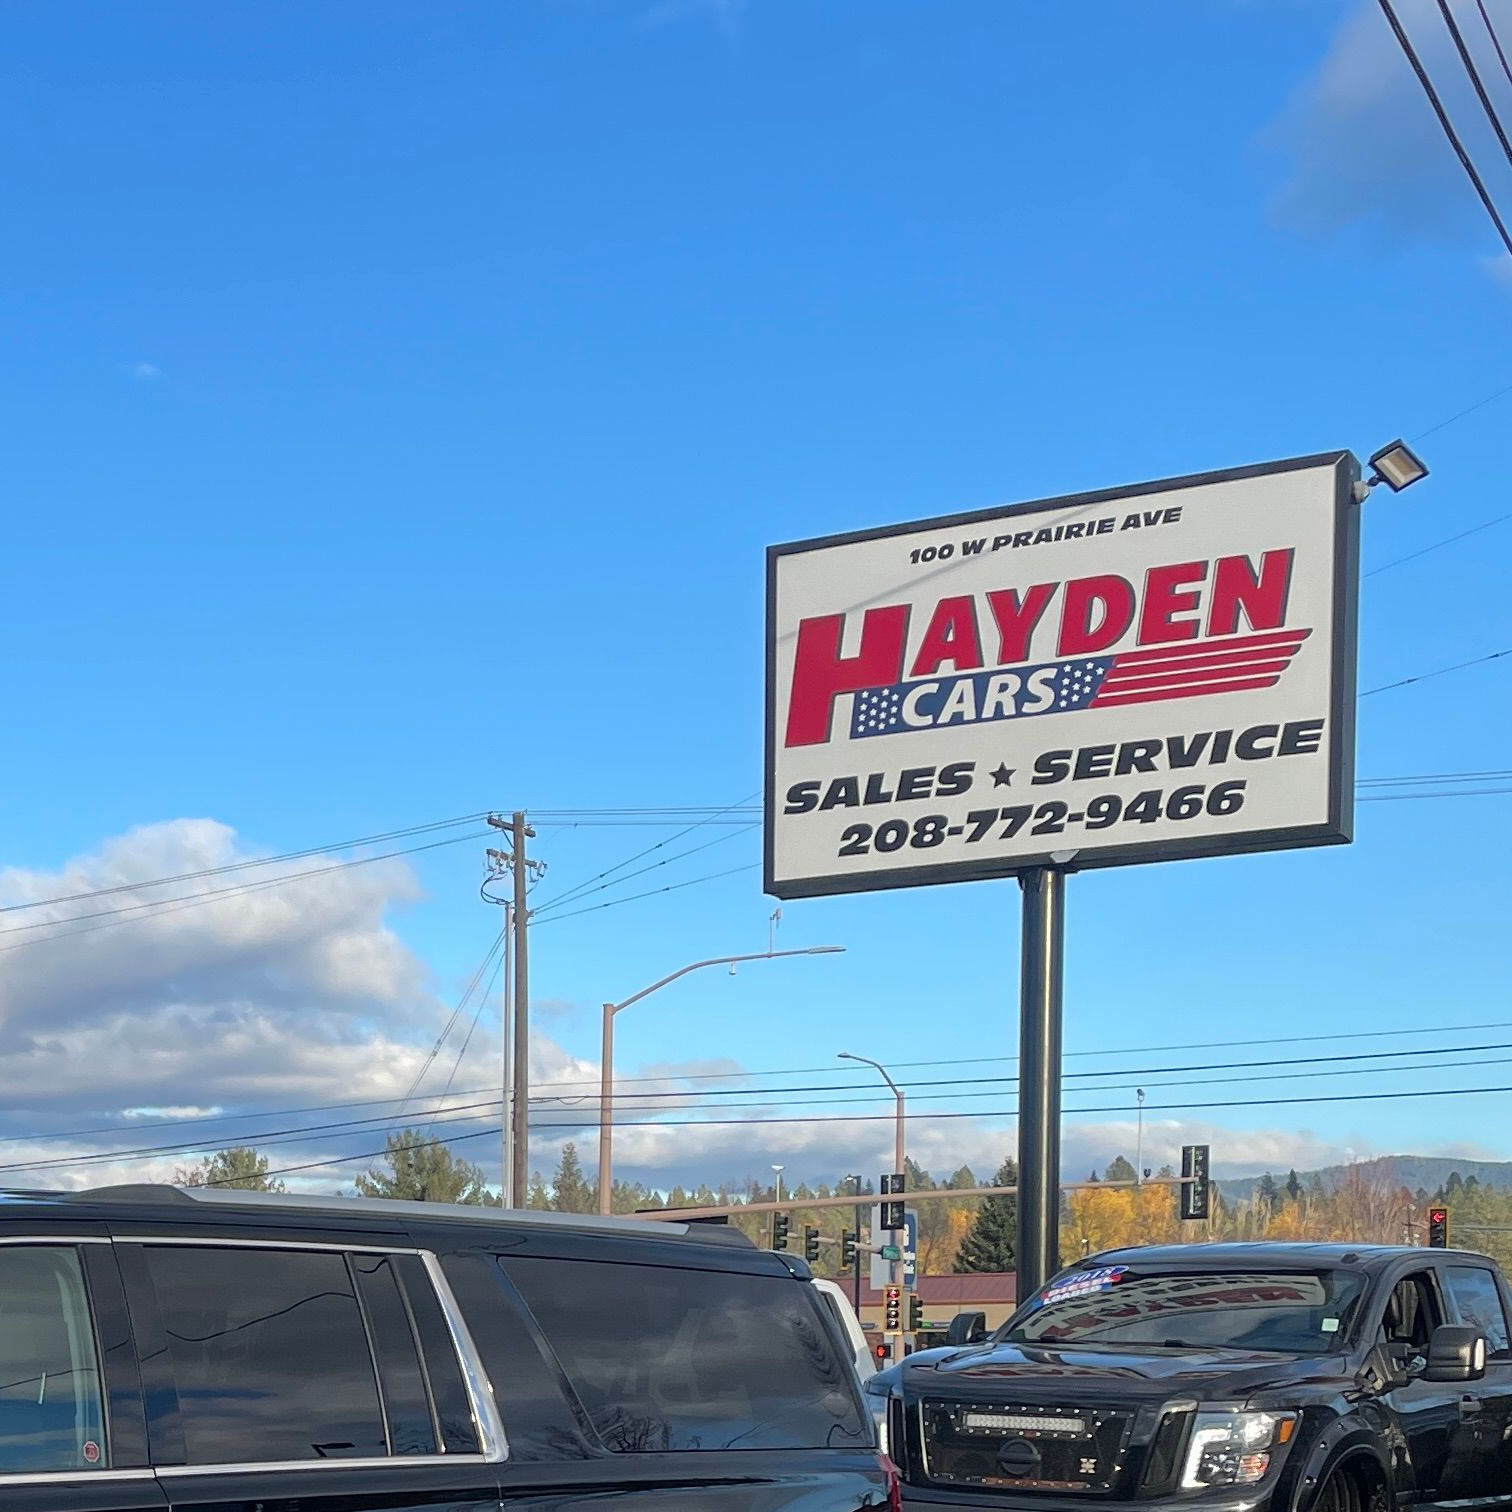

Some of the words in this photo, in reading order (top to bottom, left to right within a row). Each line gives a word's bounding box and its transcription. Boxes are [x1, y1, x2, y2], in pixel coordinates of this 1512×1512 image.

[909, 545, 953, 565] 100
[961, 538, 988, 557] W
[990, 516, 1116, 554] PRAIRIE
[1119, 505, 1184, 532] AVE
[784, 547, 1296, 748] HAYDEN
[901, 666, 1060, 730] CARS
[784, 761, 978, 815] SALES
[1030, 719, 1326, 786] SERVICE
[837, 780, 1248, 858] 208-772-9466
[1043, 1285, 1103, 1305] LOADED
[1047, 1277, 1115, 1298] DIESEL
